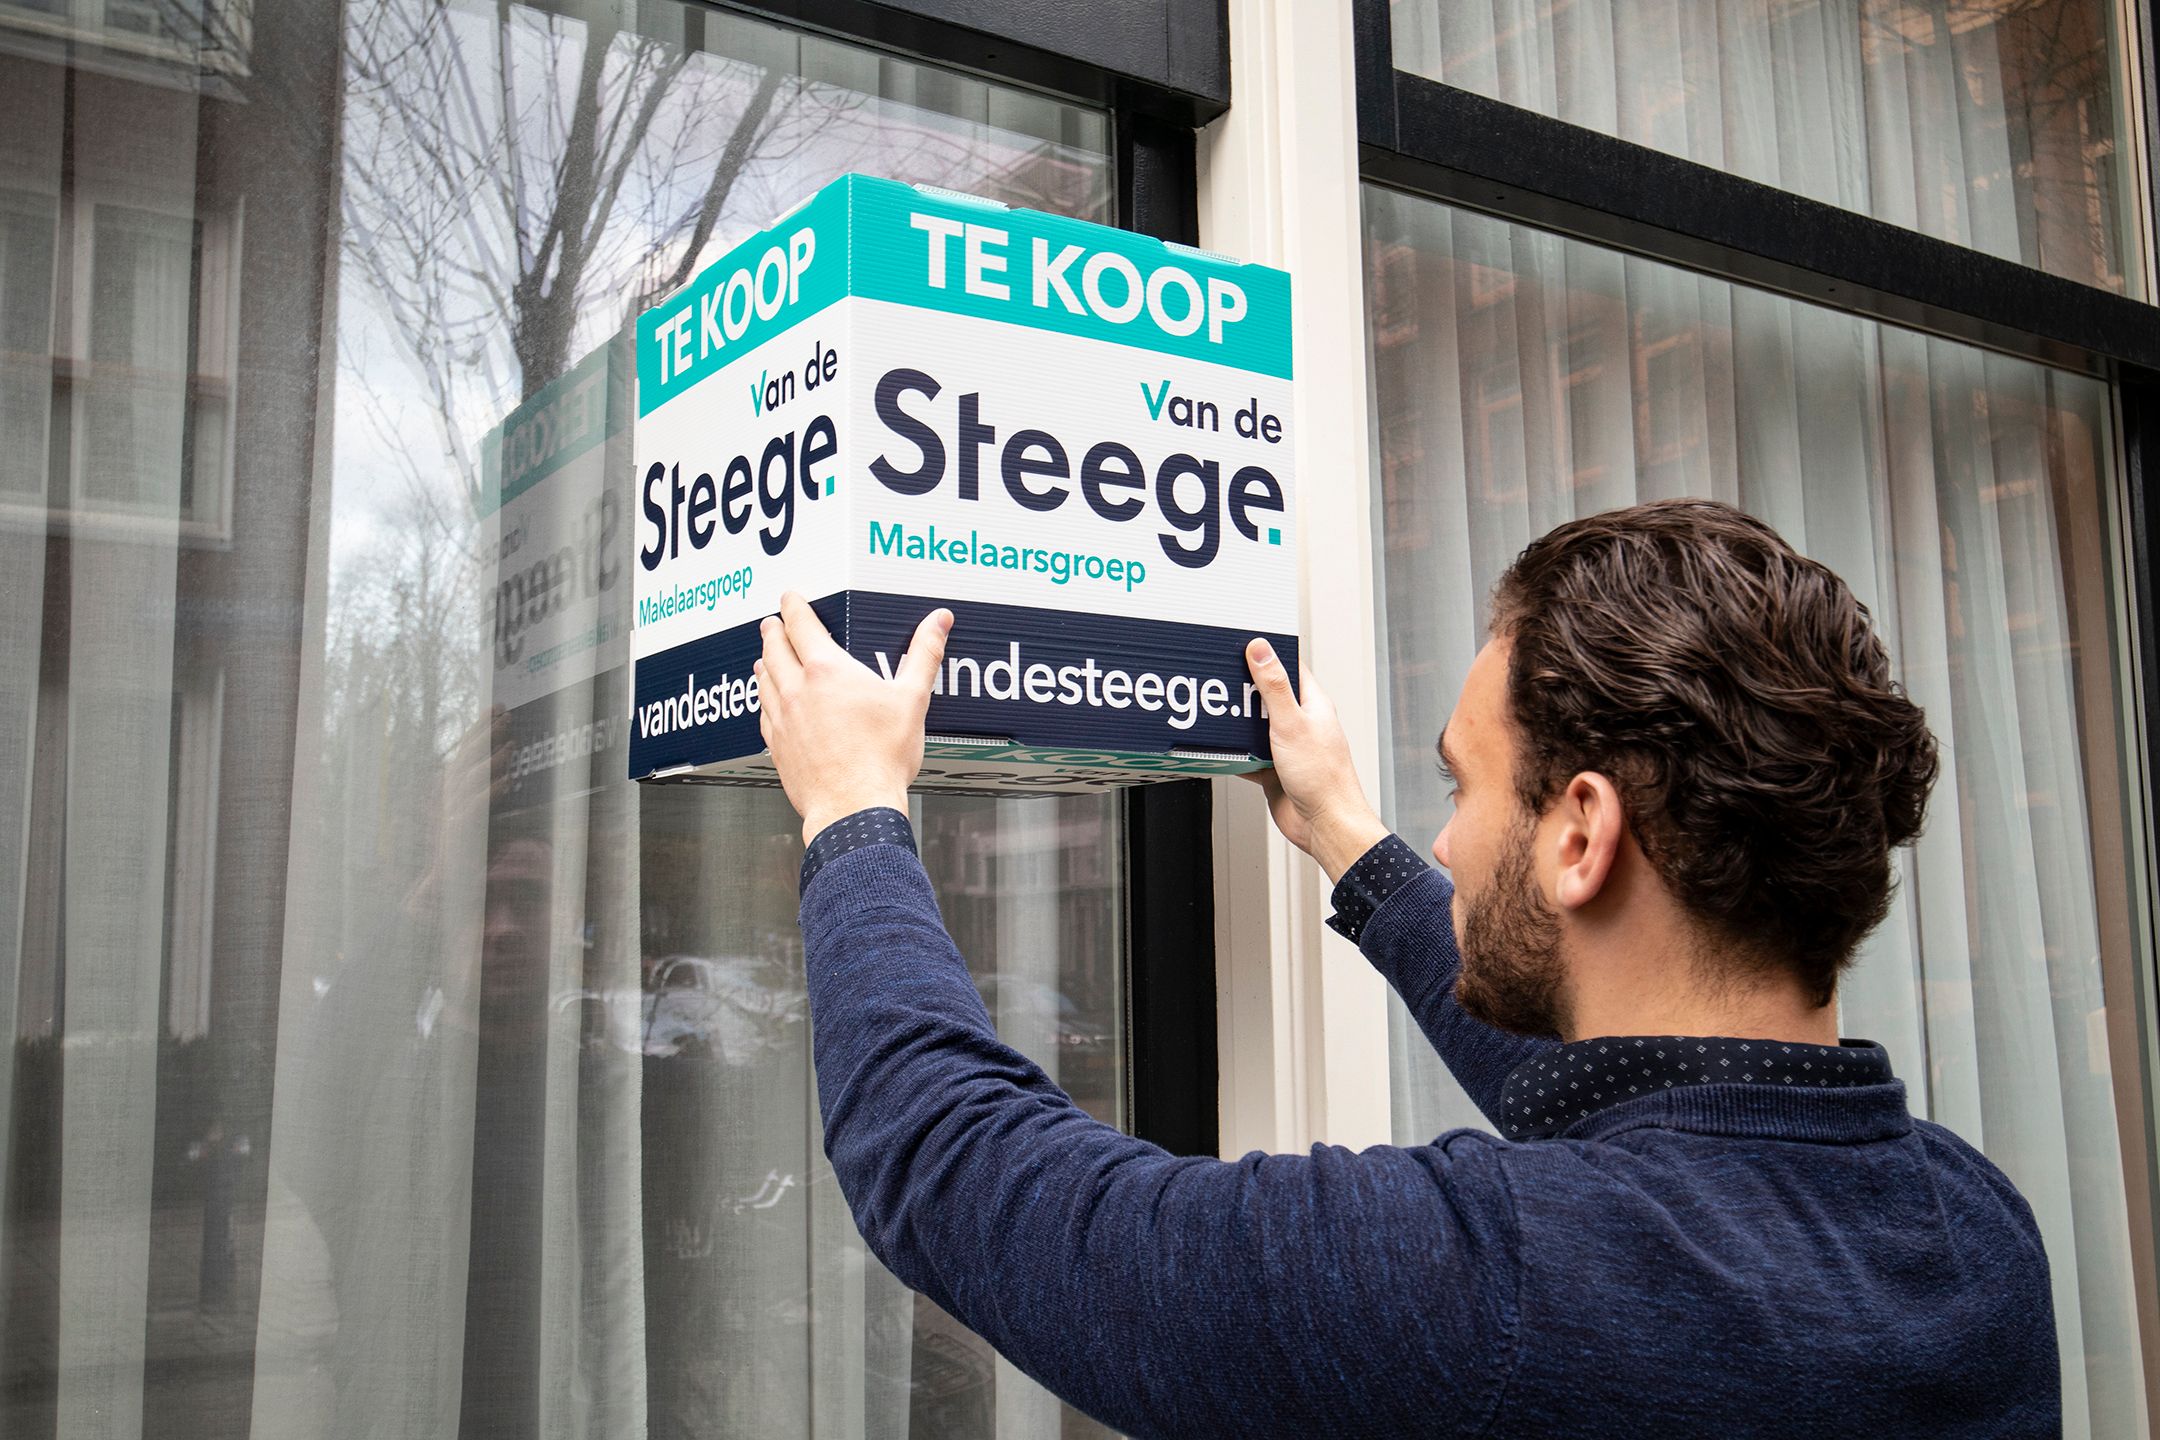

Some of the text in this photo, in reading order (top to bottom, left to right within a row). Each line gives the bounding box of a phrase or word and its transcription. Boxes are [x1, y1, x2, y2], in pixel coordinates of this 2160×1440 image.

[655, 227, 816, 385] TE KOOP
[910, 212, 1248, 345] TE KOOP
[750, 340, 838, 418] Van de
[1140, 379, 1282, 444] Van de
[640, 414, 838, 574] Steege.
[868, 368, 1285, 569] Steege.
[869, 520, 1146, 593] Makelaarsgroep
[639, 566, 753, 628] Makelaarsgroep
[639, 673, 761, 739] vandestee
[875, 642, 1268, 730] vndesteege.n
[925, 746, 1230, 769] E KOOP
